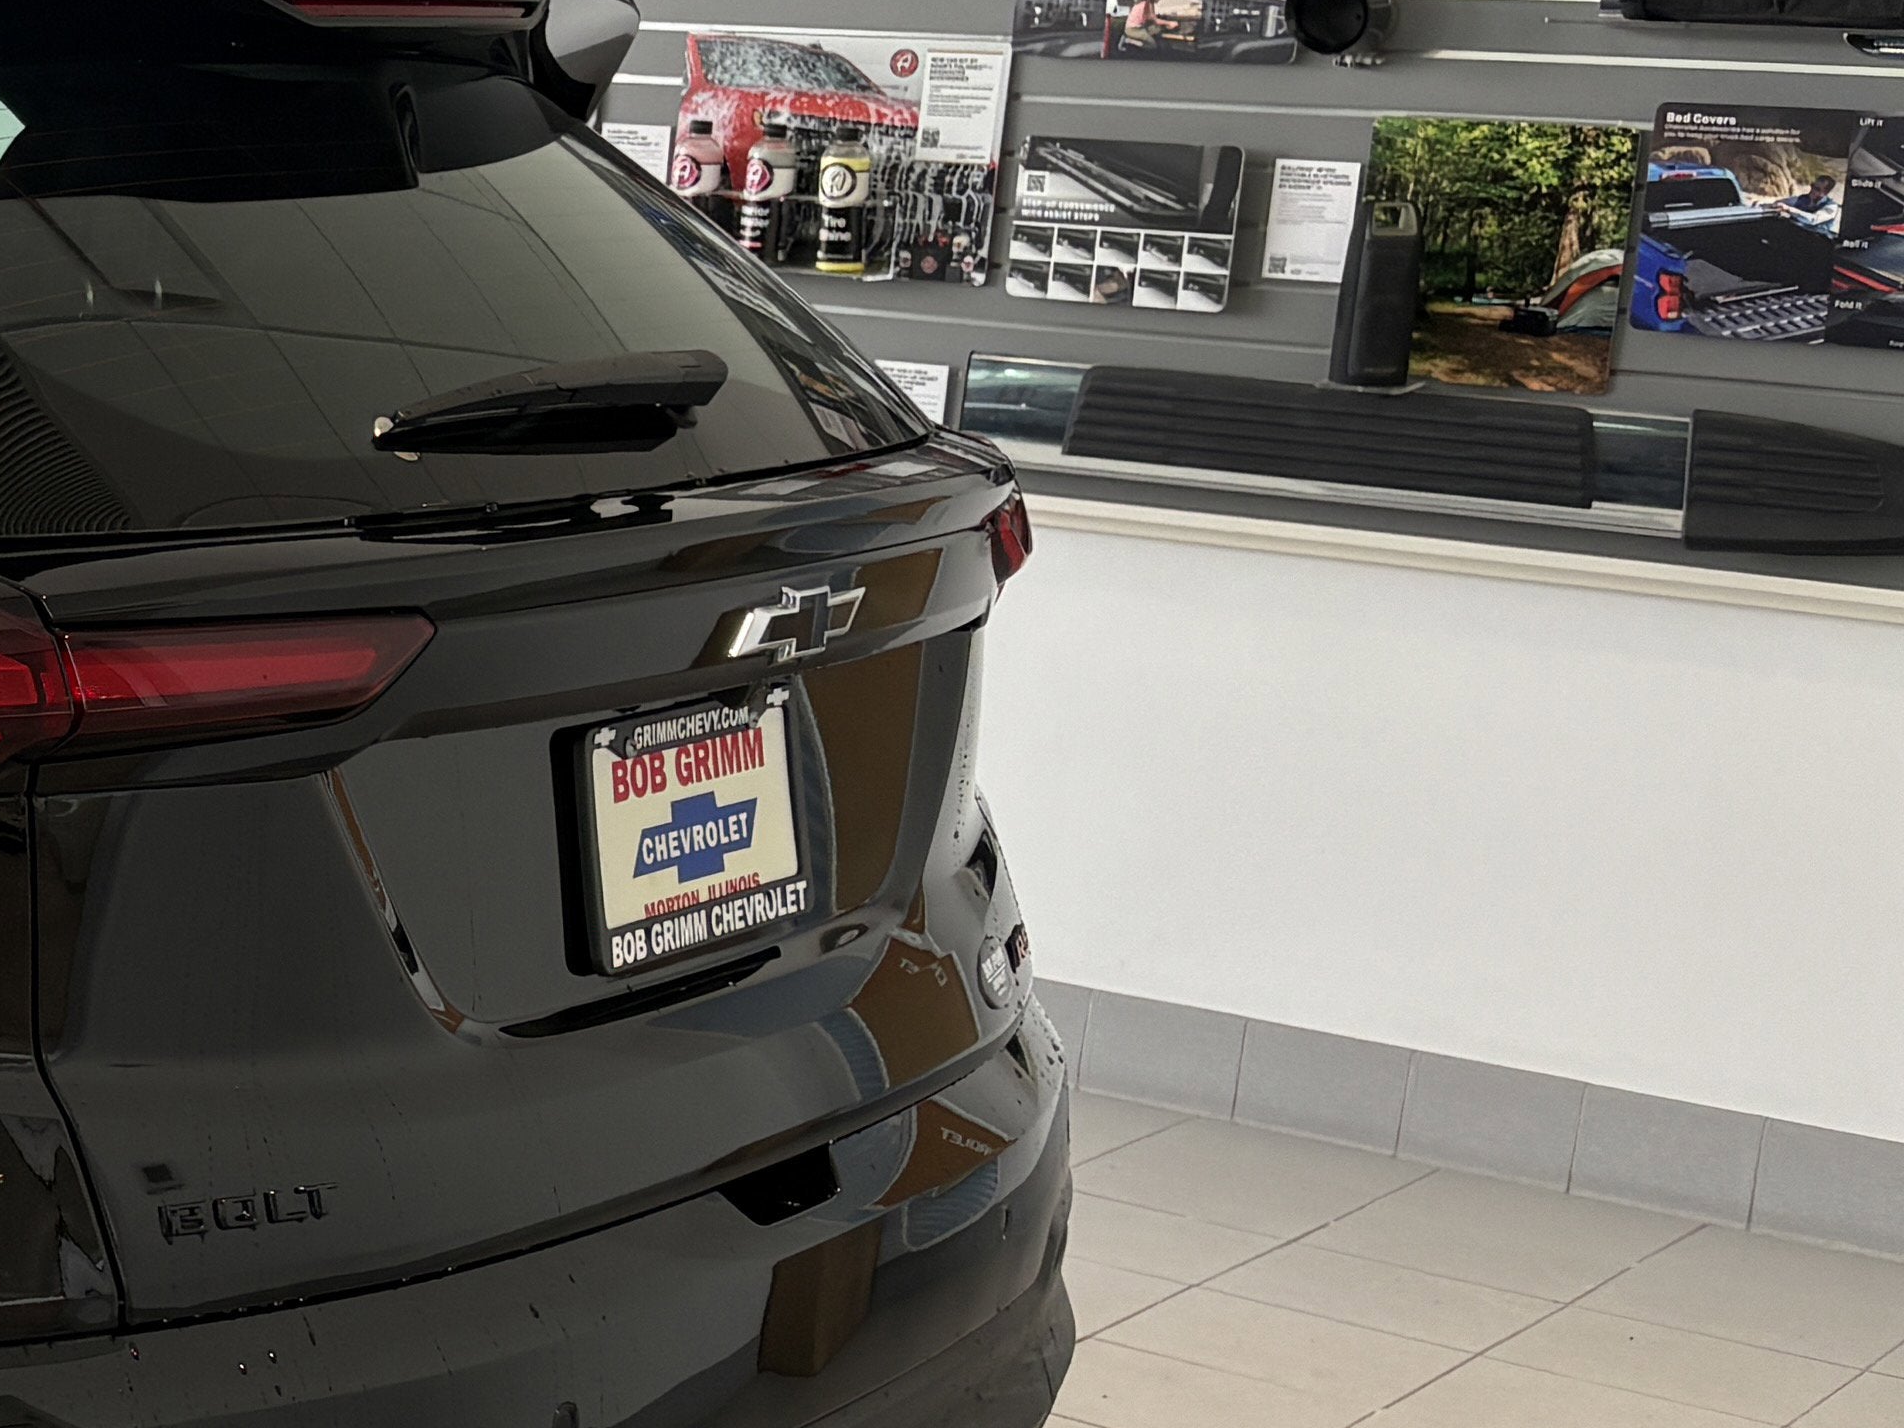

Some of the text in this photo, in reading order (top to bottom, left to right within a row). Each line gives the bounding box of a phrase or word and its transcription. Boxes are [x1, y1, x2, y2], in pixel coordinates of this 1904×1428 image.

[1666, 112, 1737, 126] Bed Covers
[1860, 117, 1876, 127] Lift
[822, 213, 846, 228] Tire
[1834, 299, 1853, 309] Fold
[633, 706, 749, 750] GRIMMCHEVY.COM
[611, 727, 765, 804] BOB GRIMM
[642, 812, 748, 865] CHEVROLET
[643, 872, 761, 920] MORTON ILLINOIS
[611, 881, 808, 969] BOB GRIMM CHEVROLET
[158, 1181, 339, 1240] BOLT
